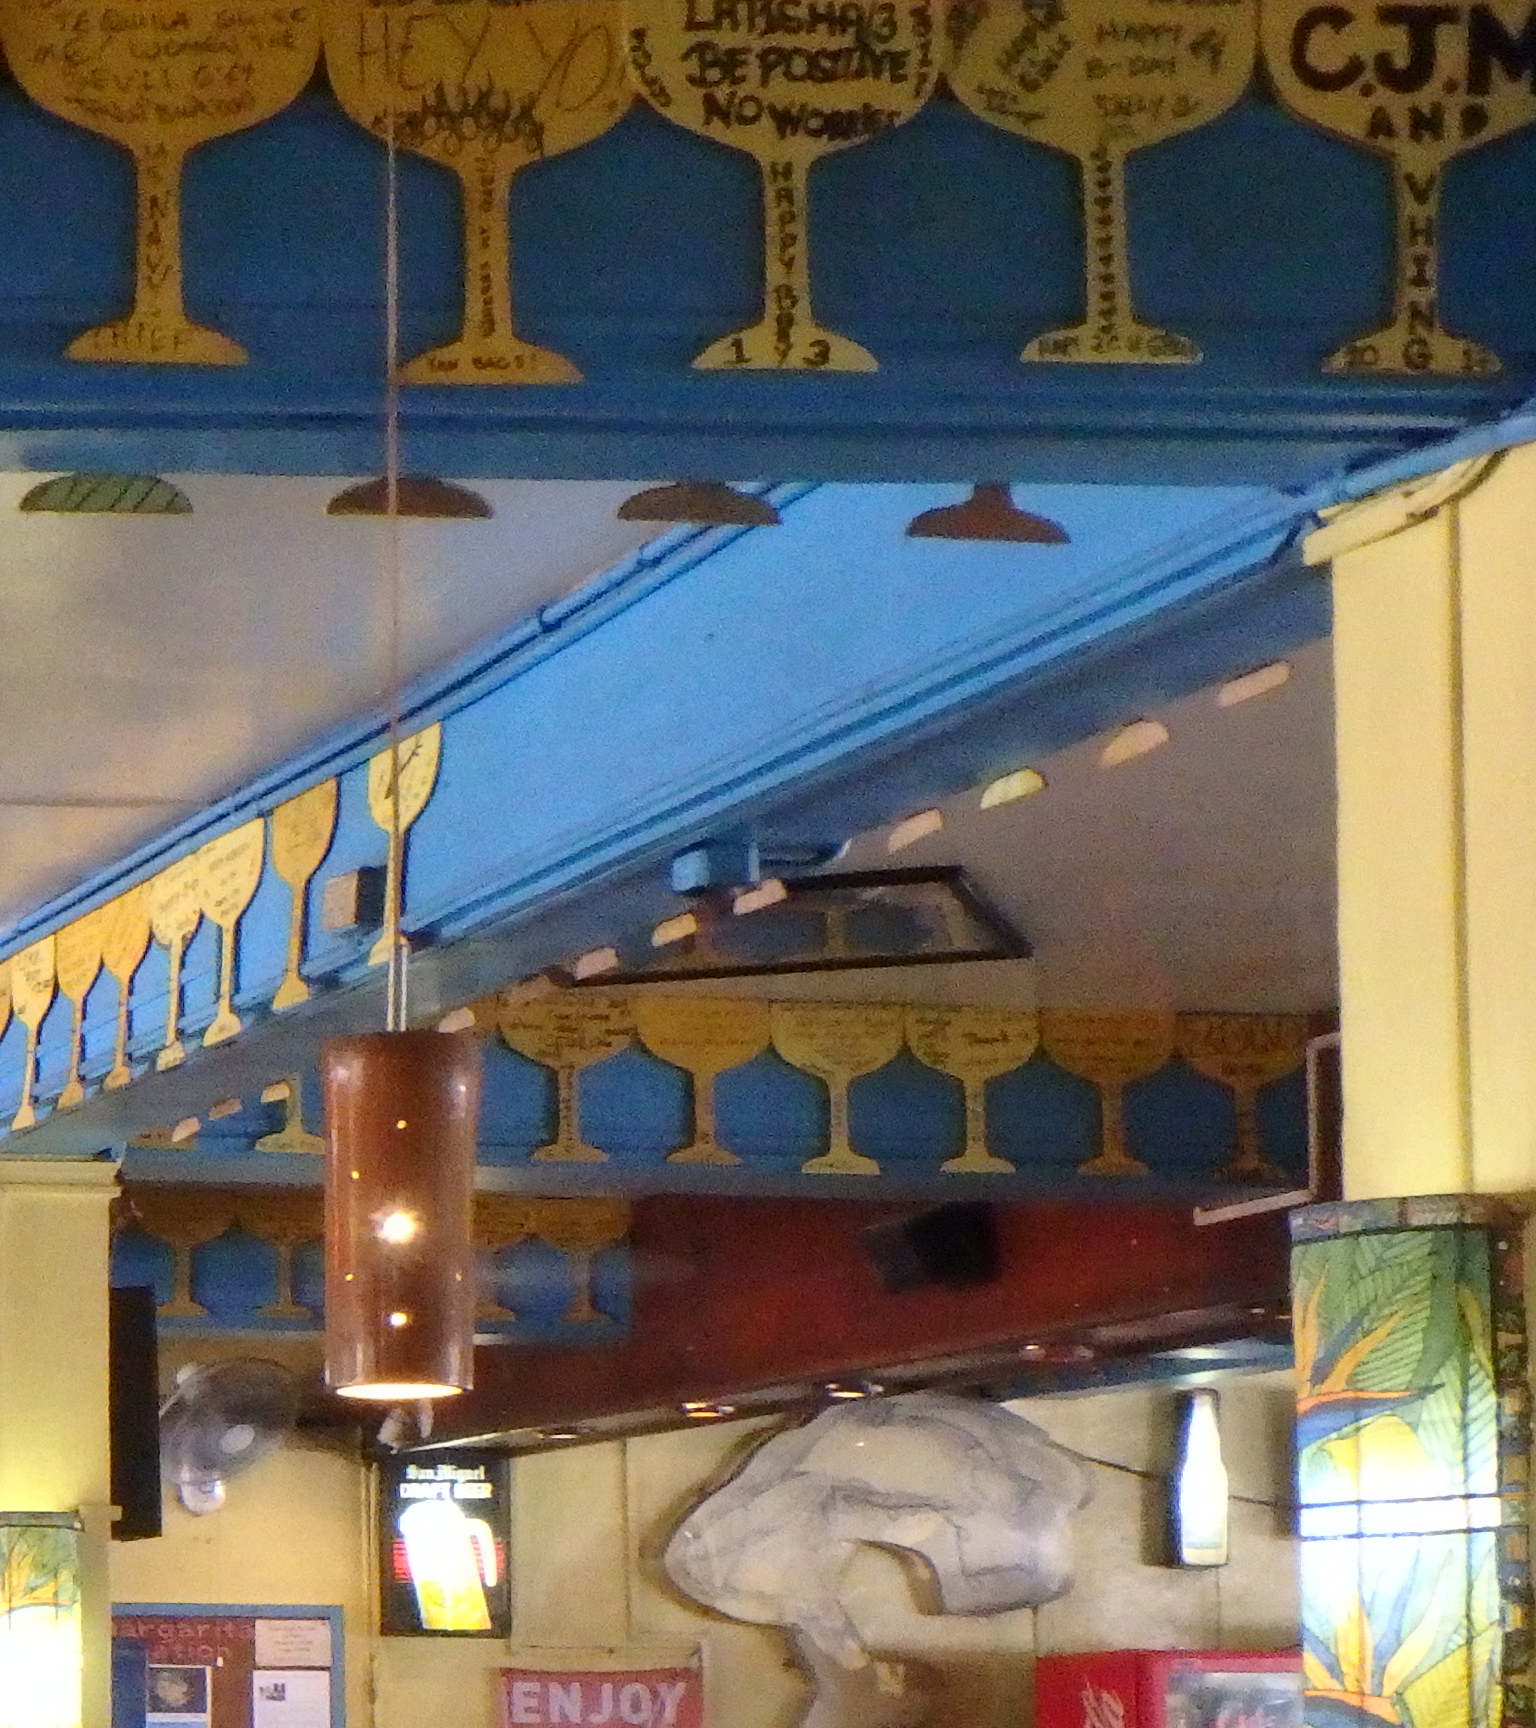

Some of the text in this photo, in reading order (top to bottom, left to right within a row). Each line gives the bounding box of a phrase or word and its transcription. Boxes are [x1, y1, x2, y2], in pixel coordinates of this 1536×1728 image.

[357, 10, 491, 92] HEY
[679, 39, 911, 88] BE POSITIVE
[702, 92, 763, 128] NO
[1366, 101, 1490, 143] AND
[118, 1620, 254, 1643] argarita
[508, 1680, 689, 1725] ENJOY
